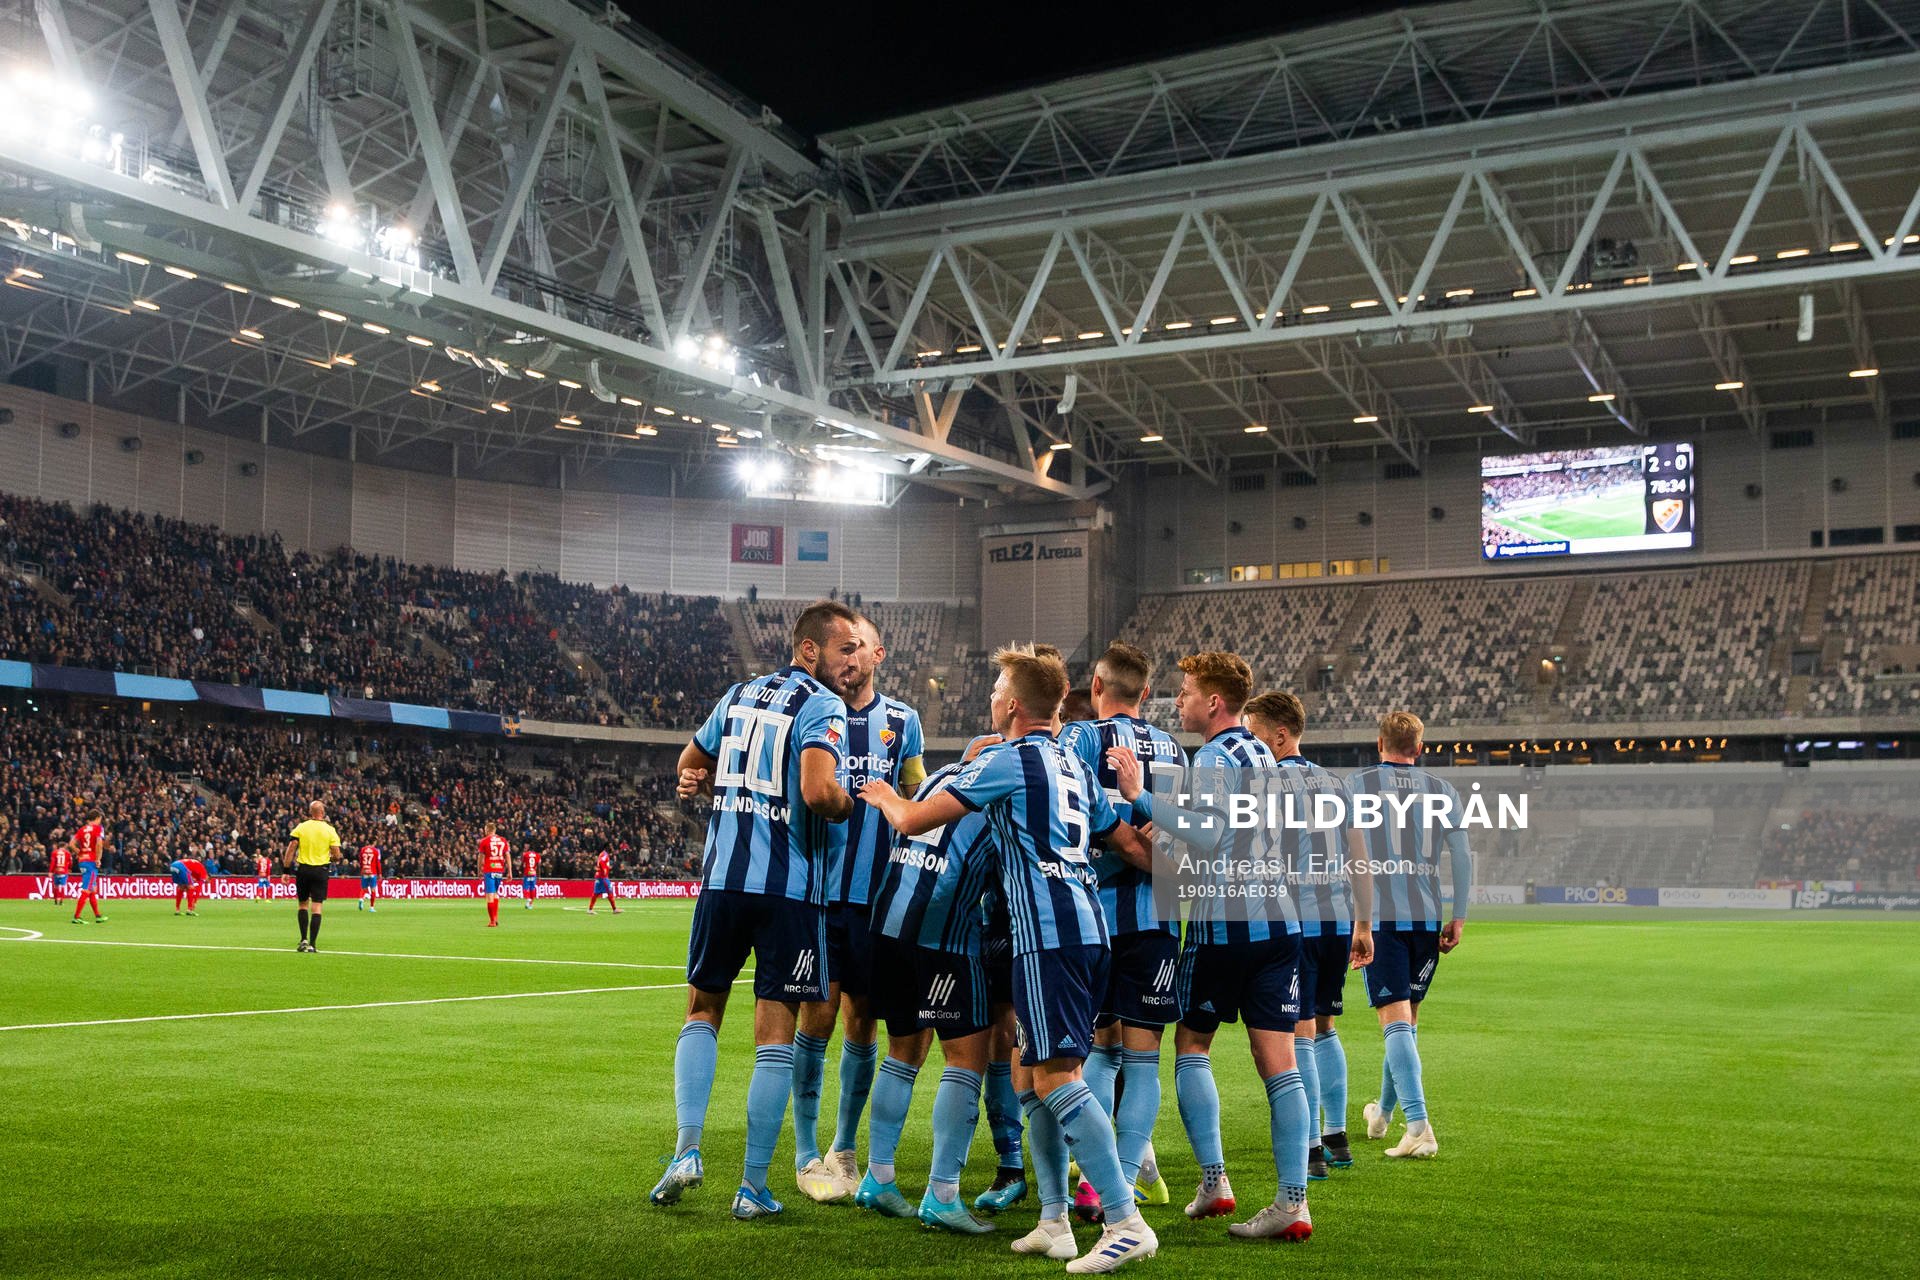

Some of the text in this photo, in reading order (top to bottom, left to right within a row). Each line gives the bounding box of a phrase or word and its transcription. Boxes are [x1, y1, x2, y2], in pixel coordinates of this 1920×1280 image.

[1649, 457, 1659, 472] 2
[1675, 455, 1687, 470] 0
[743, 530, 769, 547] JOB
[742, 550, 773, 561] ZONE
[989, 542, 1082, 563] TELE2 Arena
[714, 704, 794, 797] 20
[841, 751, 895, 776] ioritet
[1056, 772, 1091, 864] 5
[83, 832, 91, 848] 3
[489, 841, 505, 857] 57
[362, 853, 374, 865] 37
[529, 857, 535, 868] 9
[36, 877, 54, 897] Vi
[381, 880, 408, 897] fixar
[410, 880, 474, 898] likviditeten,
[618, 882, 638, 898] fixar
[1565, 887, 1628, 903] PROJOB
[1795, 891, 1830, 908] ISP
[1858, 895, 1875, 905] win
[784, 984, 801, 992] NRC
[1142, 995, 1160, 1005] NRC
[919, 1010, 960, 1020] NRC Group
